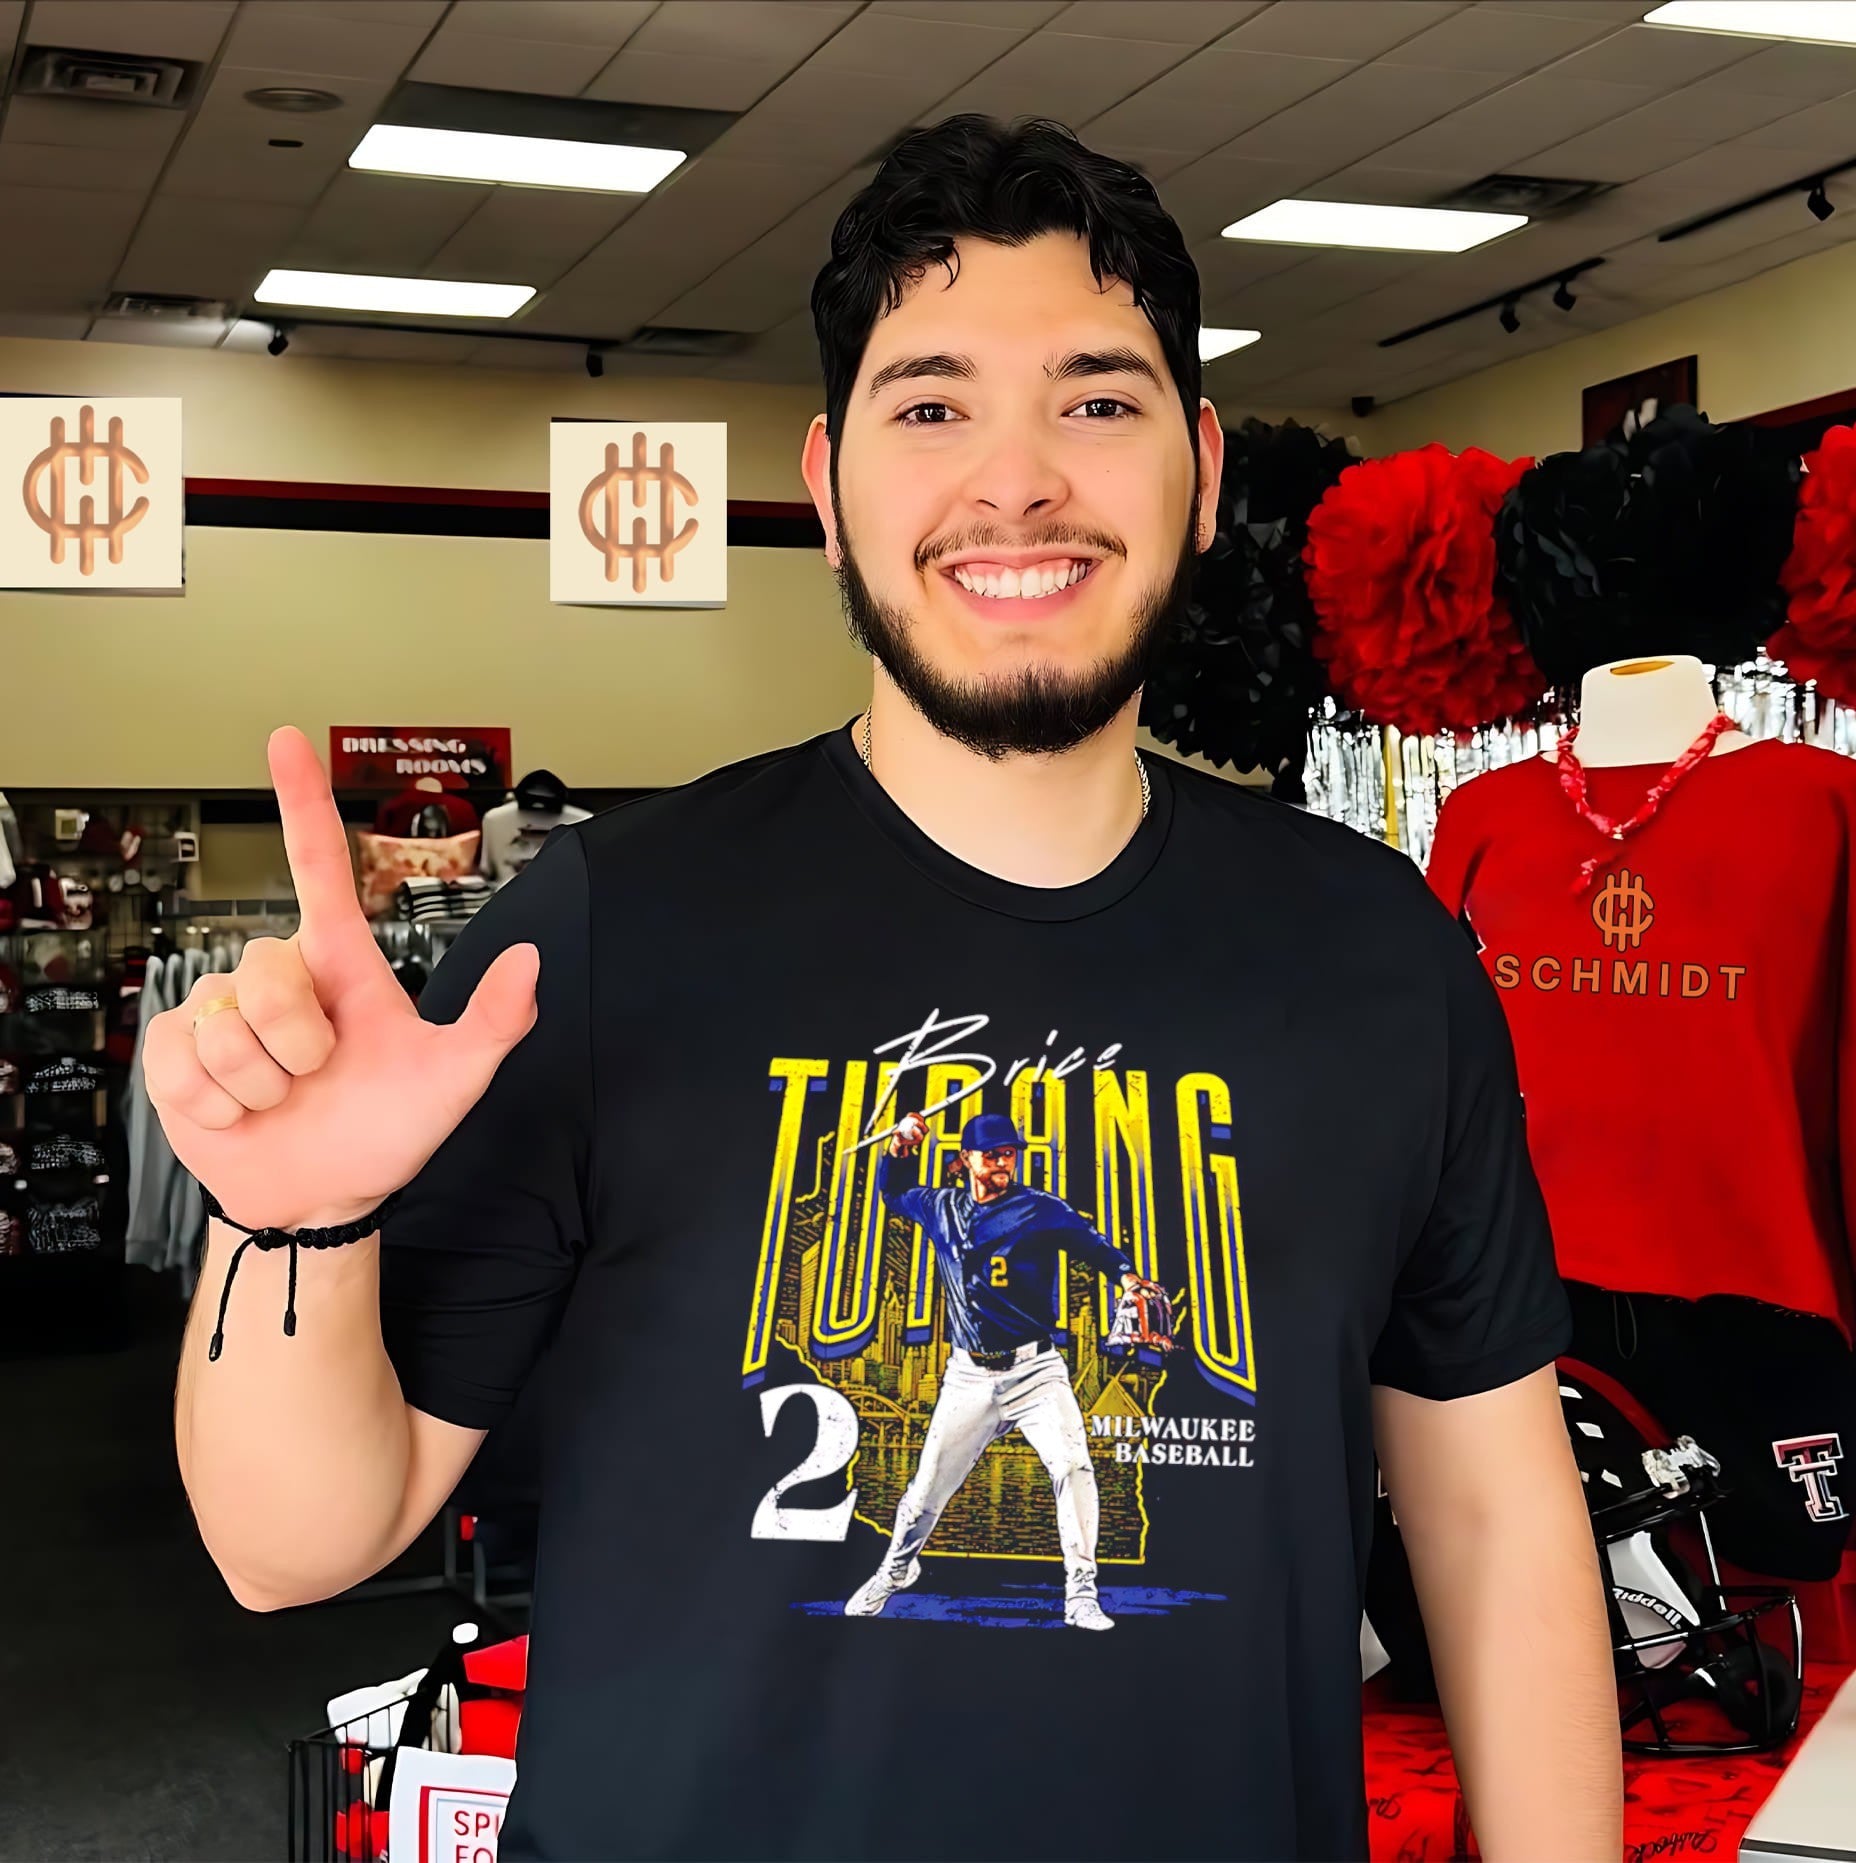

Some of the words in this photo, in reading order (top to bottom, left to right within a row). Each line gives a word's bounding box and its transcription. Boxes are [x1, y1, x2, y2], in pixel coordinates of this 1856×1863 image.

[1494, 953, 1747, 1000] SCHMIDT
[841, 1008, 1123, 1155] Brice
[990, 1255, 1009, 1287] 2
[1090, 1414, 1257, 1442] MILWAUKEE
[751, 1383, 860, 1543] 2
[1114, 1442, 1255, 1468] BASEBALL
